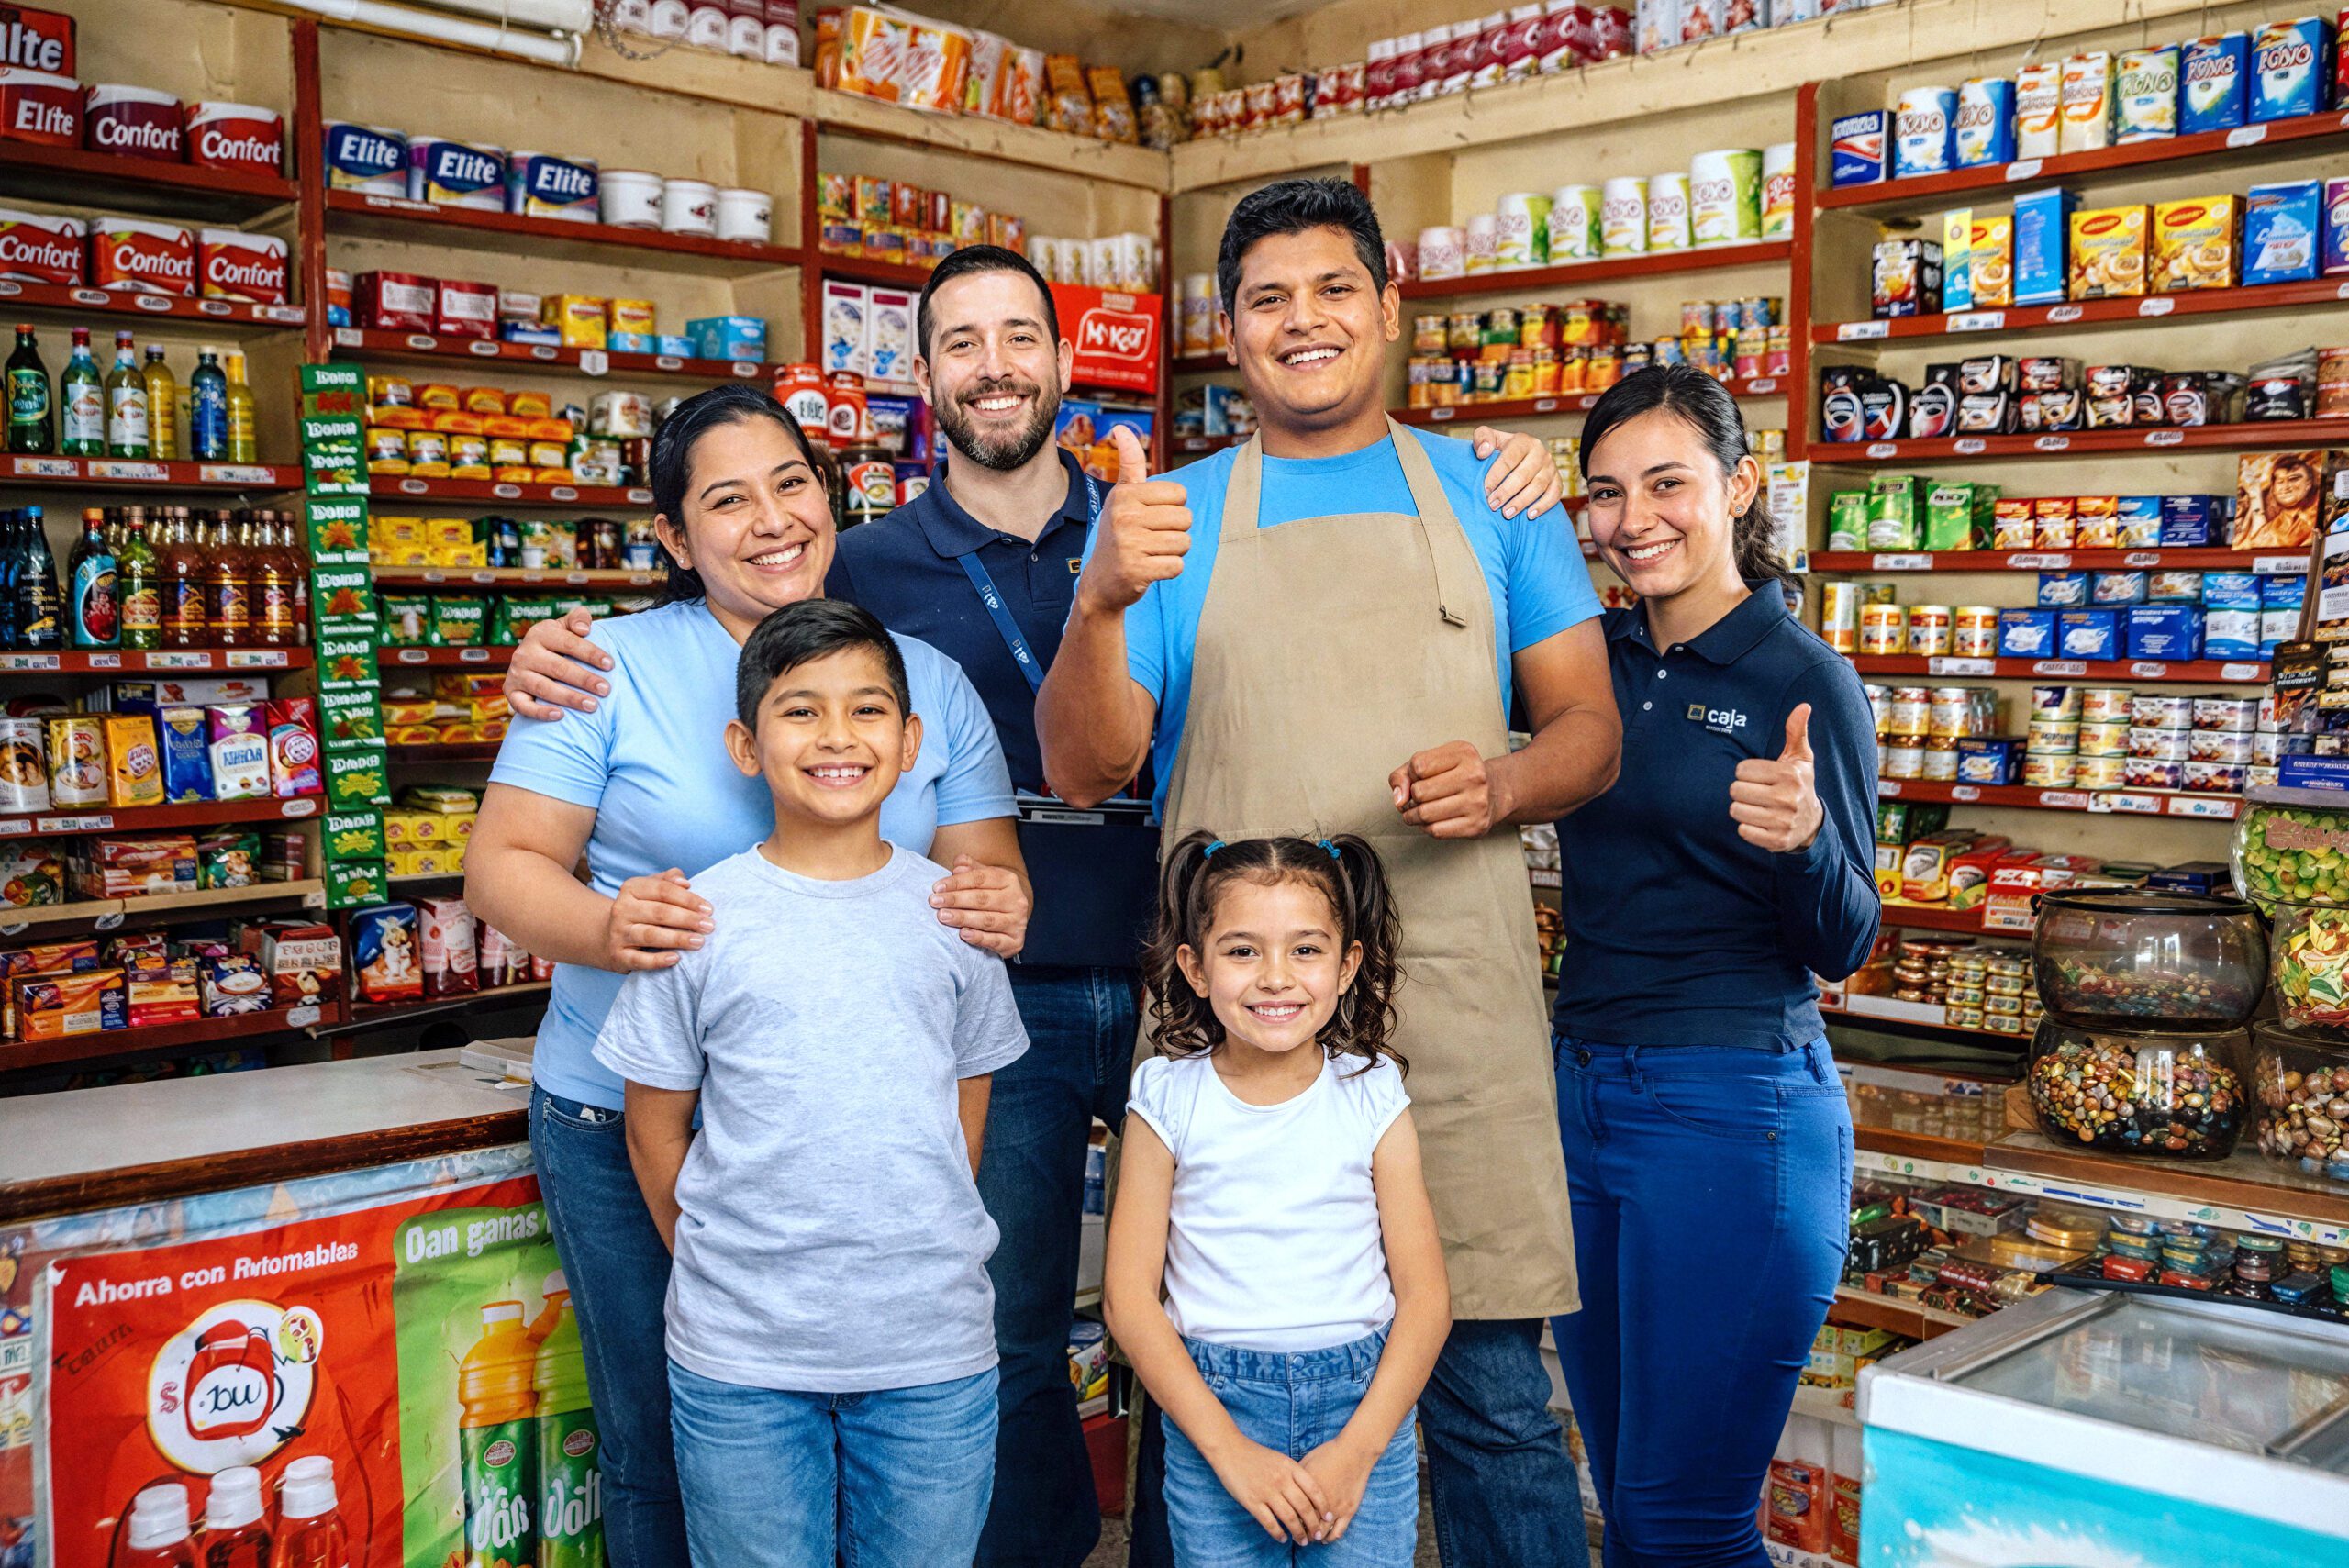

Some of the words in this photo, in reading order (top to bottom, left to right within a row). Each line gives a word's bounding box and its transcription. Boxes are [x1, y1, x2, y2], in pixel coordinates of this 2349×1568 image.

[96, 117, 179, 151] Confort
[201, 130, 281, 164] Confort
[339, 134, 399, 168] Elite
[437, 150, 497, 183] Elite
[535, 163, 593, 195] Elite
[0, 235, 81, 270] Confort
[114, 244, 194, 277] Confort
[208, 256, 284, 288] Confort
[466, 1210, 540, 1258] ganas
[74, 1277, 173, 1308] Ahorra
[179, 1265, 226, 1290] con
